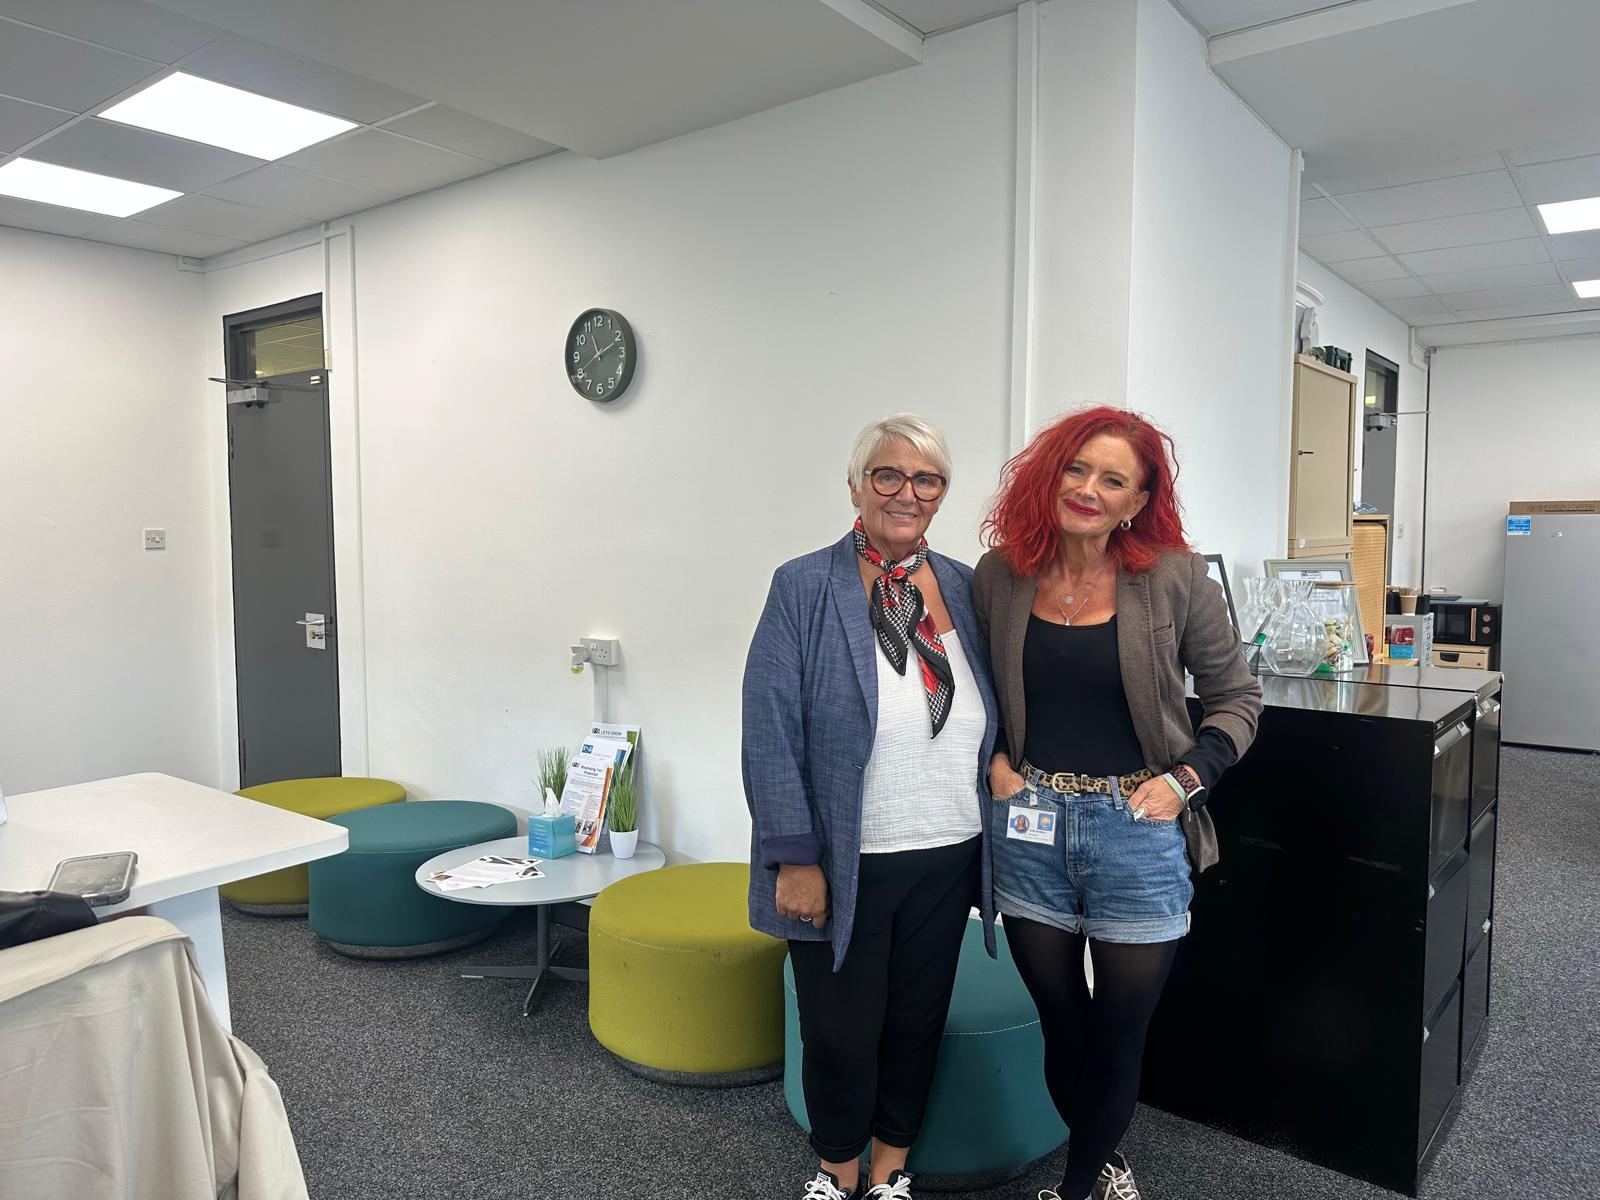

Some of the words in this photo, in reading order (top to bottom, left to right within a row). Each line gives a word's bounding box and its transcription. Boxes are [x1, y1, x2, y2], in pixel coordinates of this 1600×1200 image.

[584, 321, 591, 332] 11
[593, 315, 603, 327] 12
[607, 317, 612, 330] 1
[576, 334, 586, 346] 10
[615, 330, 622, 341] 2
[573, 351, 580, 363] 9
[619, 346, 625, 358] 3
[577, 368, 584, 379] 8
[616, 363, 622, 375] 4
[586, 379, 592, 390] 7
[596, 383, 603, 395] 6
[608, 377, 614, 389] 5
